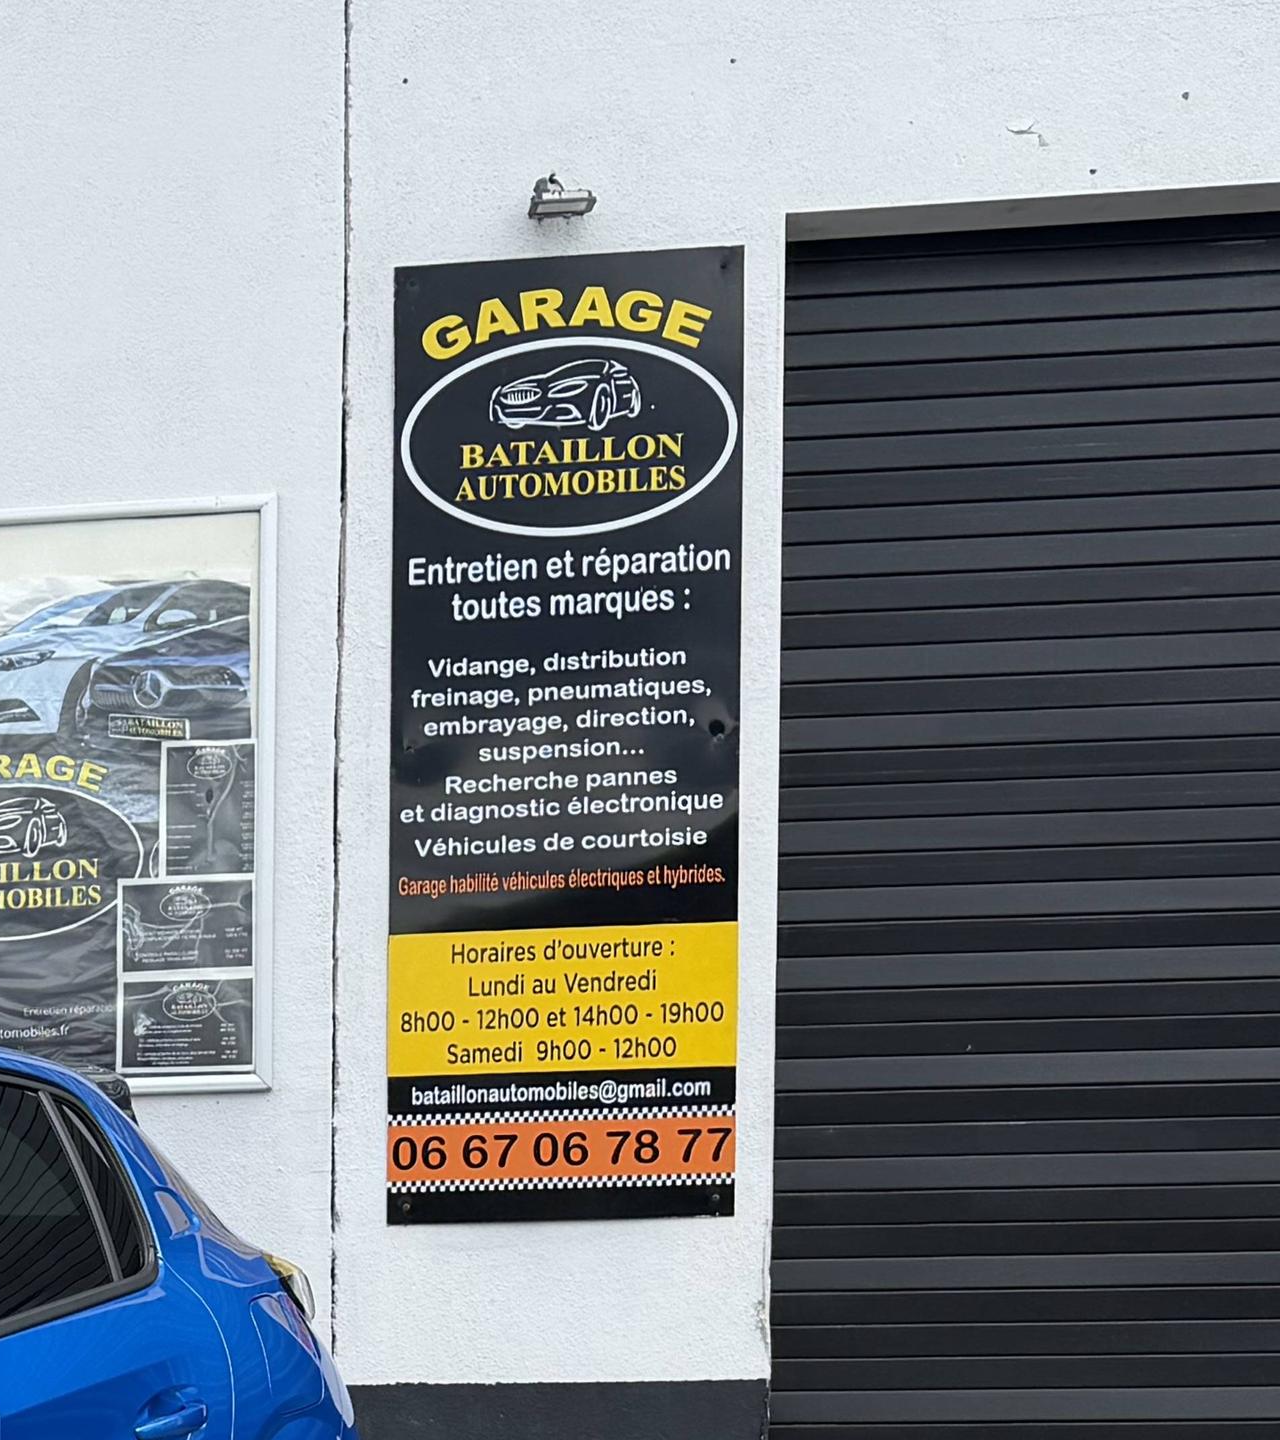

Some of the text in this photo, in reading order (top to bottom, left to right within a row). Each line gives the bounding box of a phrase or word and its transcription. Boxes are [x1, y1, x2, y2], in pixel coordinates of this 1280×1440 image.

[421, 286, 713, 360] GARAGE
[459, 432, 685, 469] BATAILLON
[454, 464, 686, 501] AUTOMOBILES
[408, 543, 731, 586] Entretien et réparation
[452, 590, 541, 621] toutes
[550, 585, 675, 621] marques
[427, 647, 687, 679] Vidange, distribution
[411, 677, 712, 711] freinage, pneumatiques,
[423, 706, 696, 737] embrayage, direction,
[478, 738, 645, 765] suspension...
[445, 768, 678, 795] Recherche pannes
[399, 790, 724, 825] et diagnostic électronique
[414, 826, 708, 858] Véhicules de courtoisie
[398, 864, 726, 900] Garage habilité véhicules électriques et hybrides.
[451, 940, 536, 965] Horaires
[543, 937, 663, 961] d'ouverture
[468, 969, 657, 998] Lundi au Vendredi
[400, 1009, 455, 1033] 8h00
[477, 1007, 539, 1030] 12h00
[547, 1008, 567, 1028] et
[573, 1004, 638, 1027] 14h00
[660, 1000, 725, 1024] 19h00
[446, 1041, 523, 1065] Samedi
[536, 1039, 592, 1062] 9h00
[614, 1036, 677, 1059] 12h00
[411, 1077, 711, 1107] bataillonautomobiles@gmail.com
[391, 1127, 733, 1171] 06 67 06 78 77
